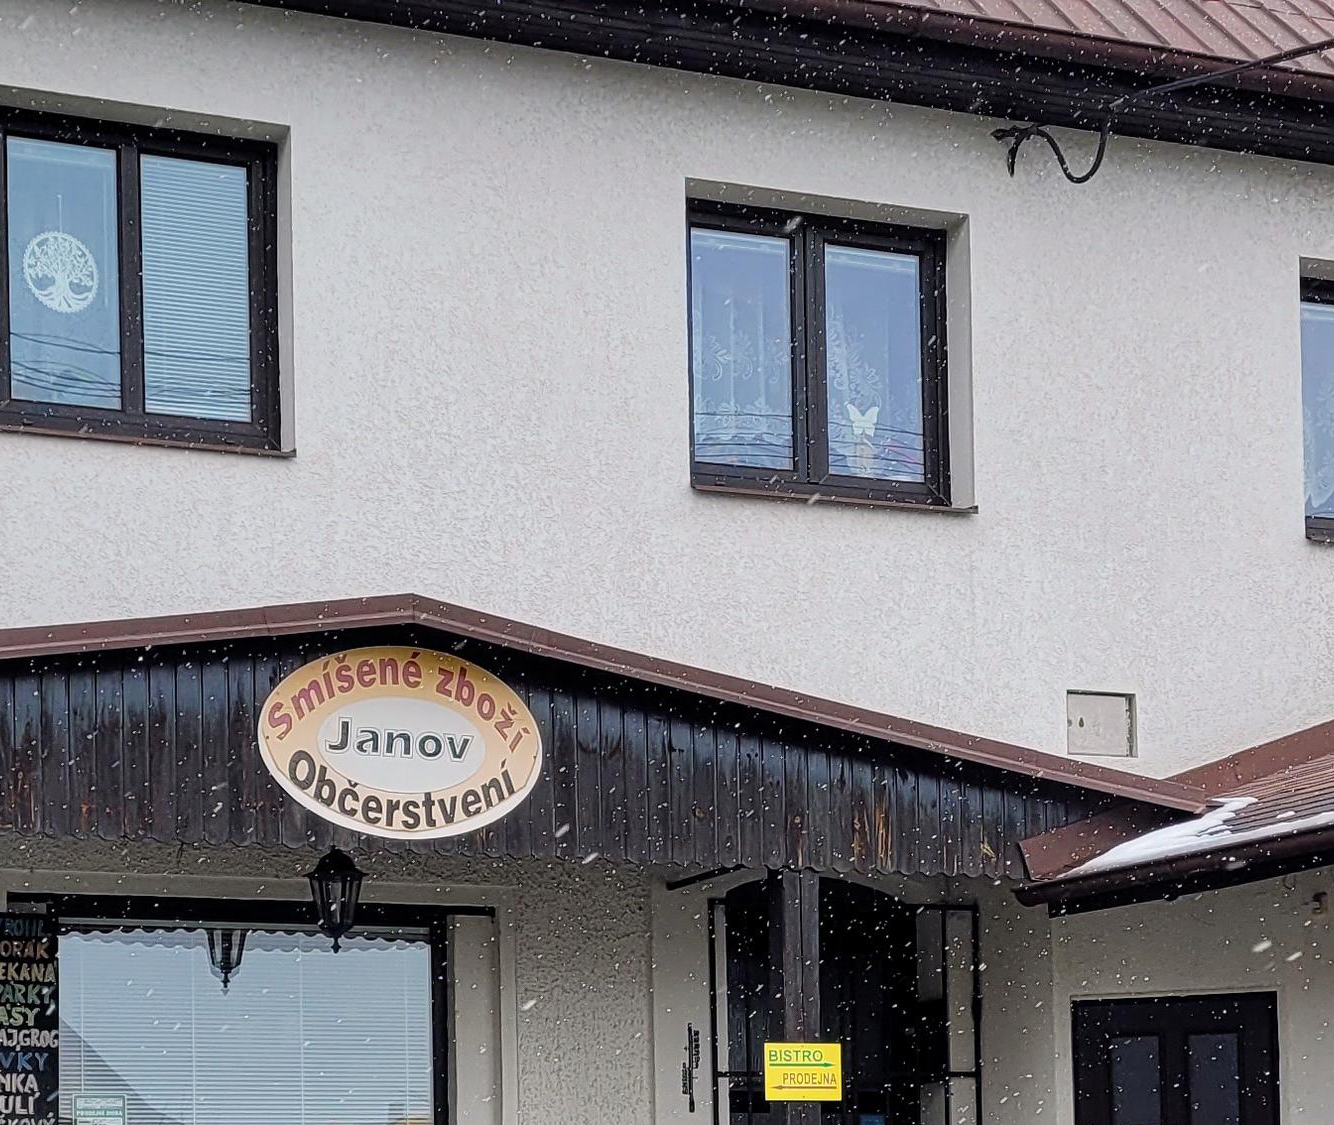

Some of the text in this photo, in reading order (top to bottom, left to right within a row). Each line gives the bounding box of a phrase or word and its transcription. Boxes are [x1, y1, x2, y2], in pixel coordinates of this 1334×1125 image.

[267, 652, 530, 753] Smíšené zboží
[326, 717, 471, 761] Janov
[288, 749, 515, 829] Občerstvení
[769, 1050, 823, 1062] BISTRO
[783, 1073, 837, 1085] PRODEJNA
